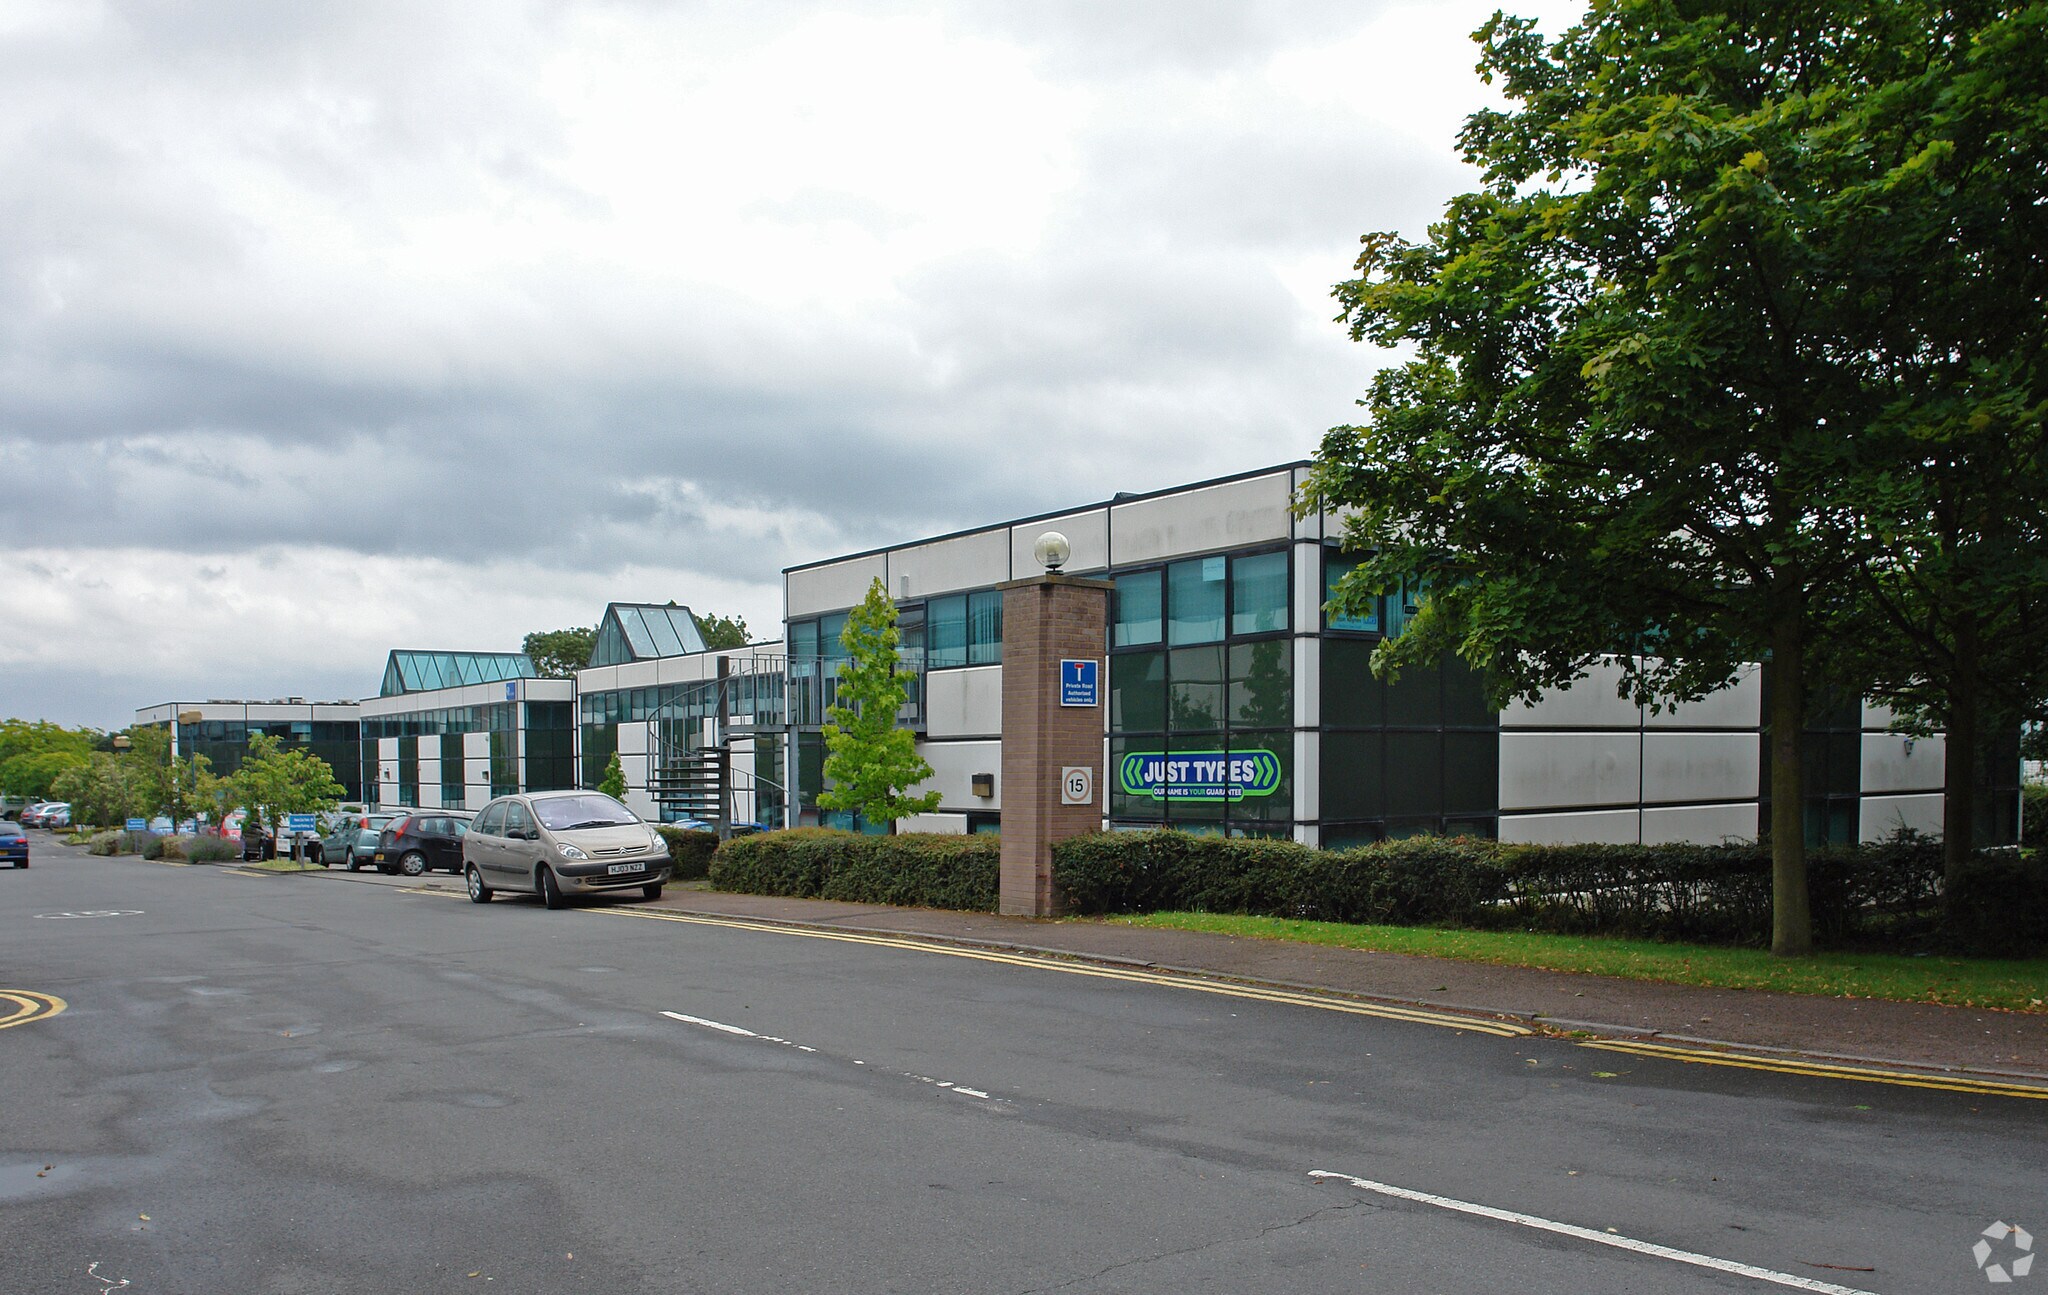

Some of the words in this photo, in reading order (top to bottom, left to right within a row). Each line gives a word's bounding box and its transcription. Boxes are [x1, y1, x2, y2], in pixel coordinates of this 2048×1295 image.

[1144, 761, 1190, 782] JUST
[1193, 760, 1255, 782] TYRES
[1069, 778, 1084, 793] 15
[1182, 788, 1189, 796] IS
[1189, 788, 1205, 796] YOUR
